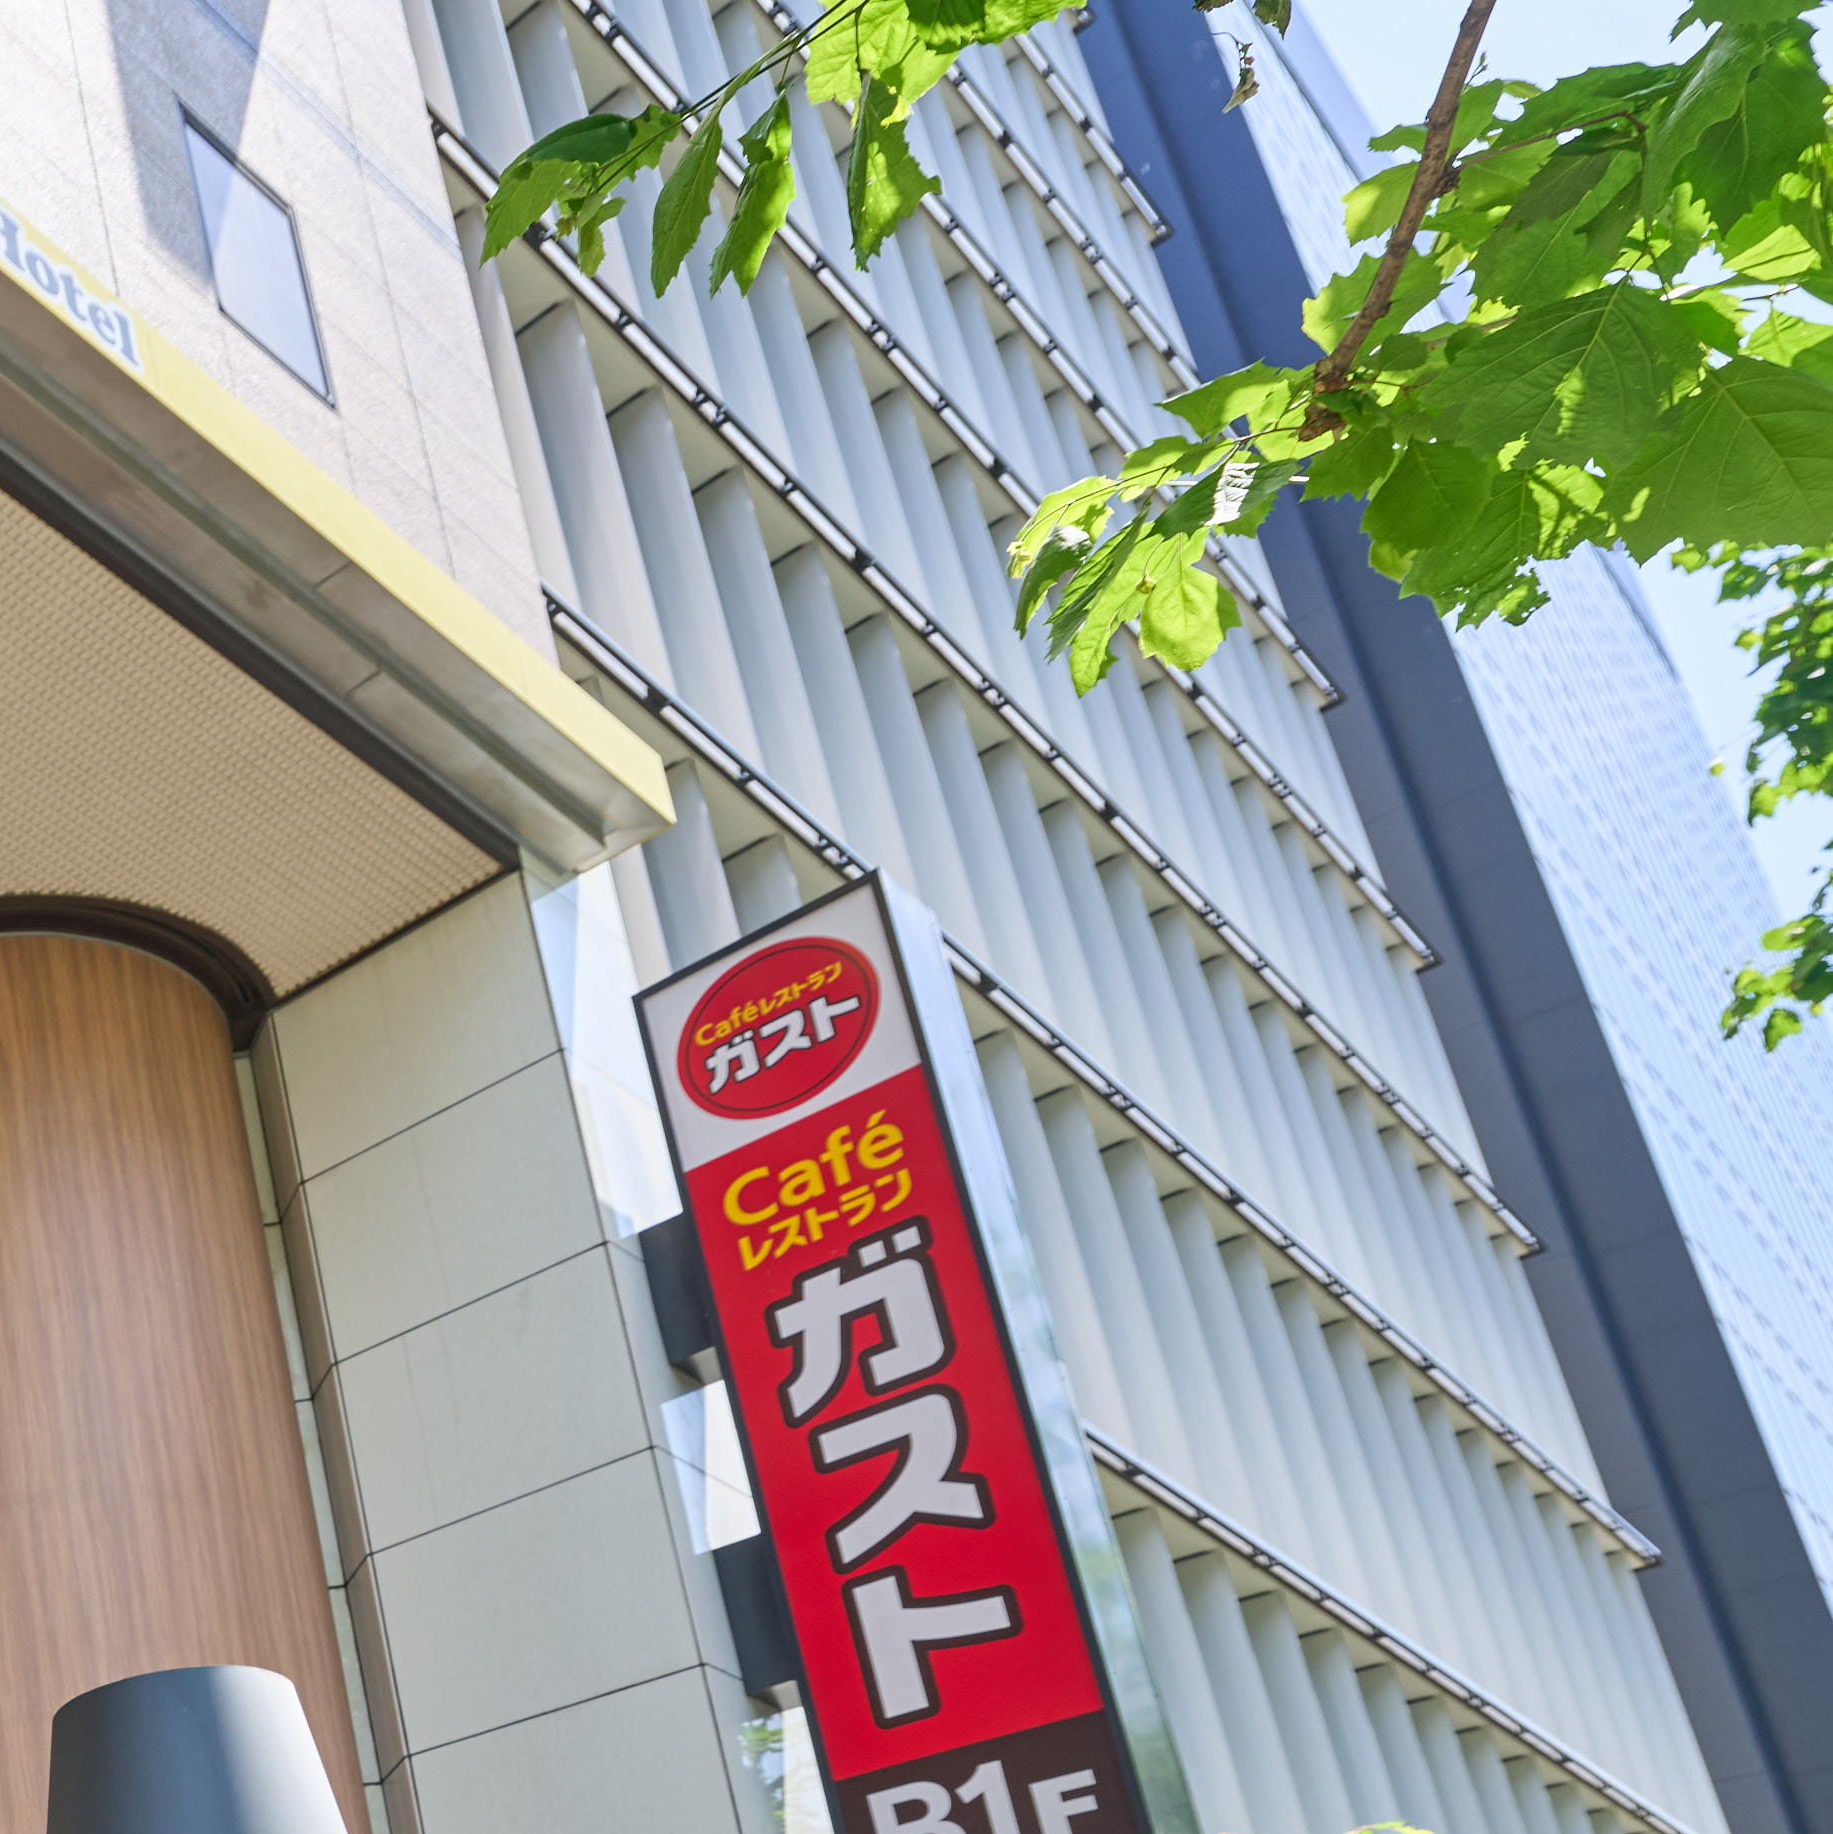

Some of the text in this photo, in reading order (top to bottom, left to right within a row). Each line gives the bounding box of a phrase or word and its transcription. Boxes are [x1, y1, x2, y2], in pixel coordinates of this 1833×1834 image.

[704, 994, 861, 1096] ガスト
[723, 1109, 905, 1227] Café
[737, 1168, 913, 1271] レストラン
[769, 1219, 1017, 1724] ガスト
